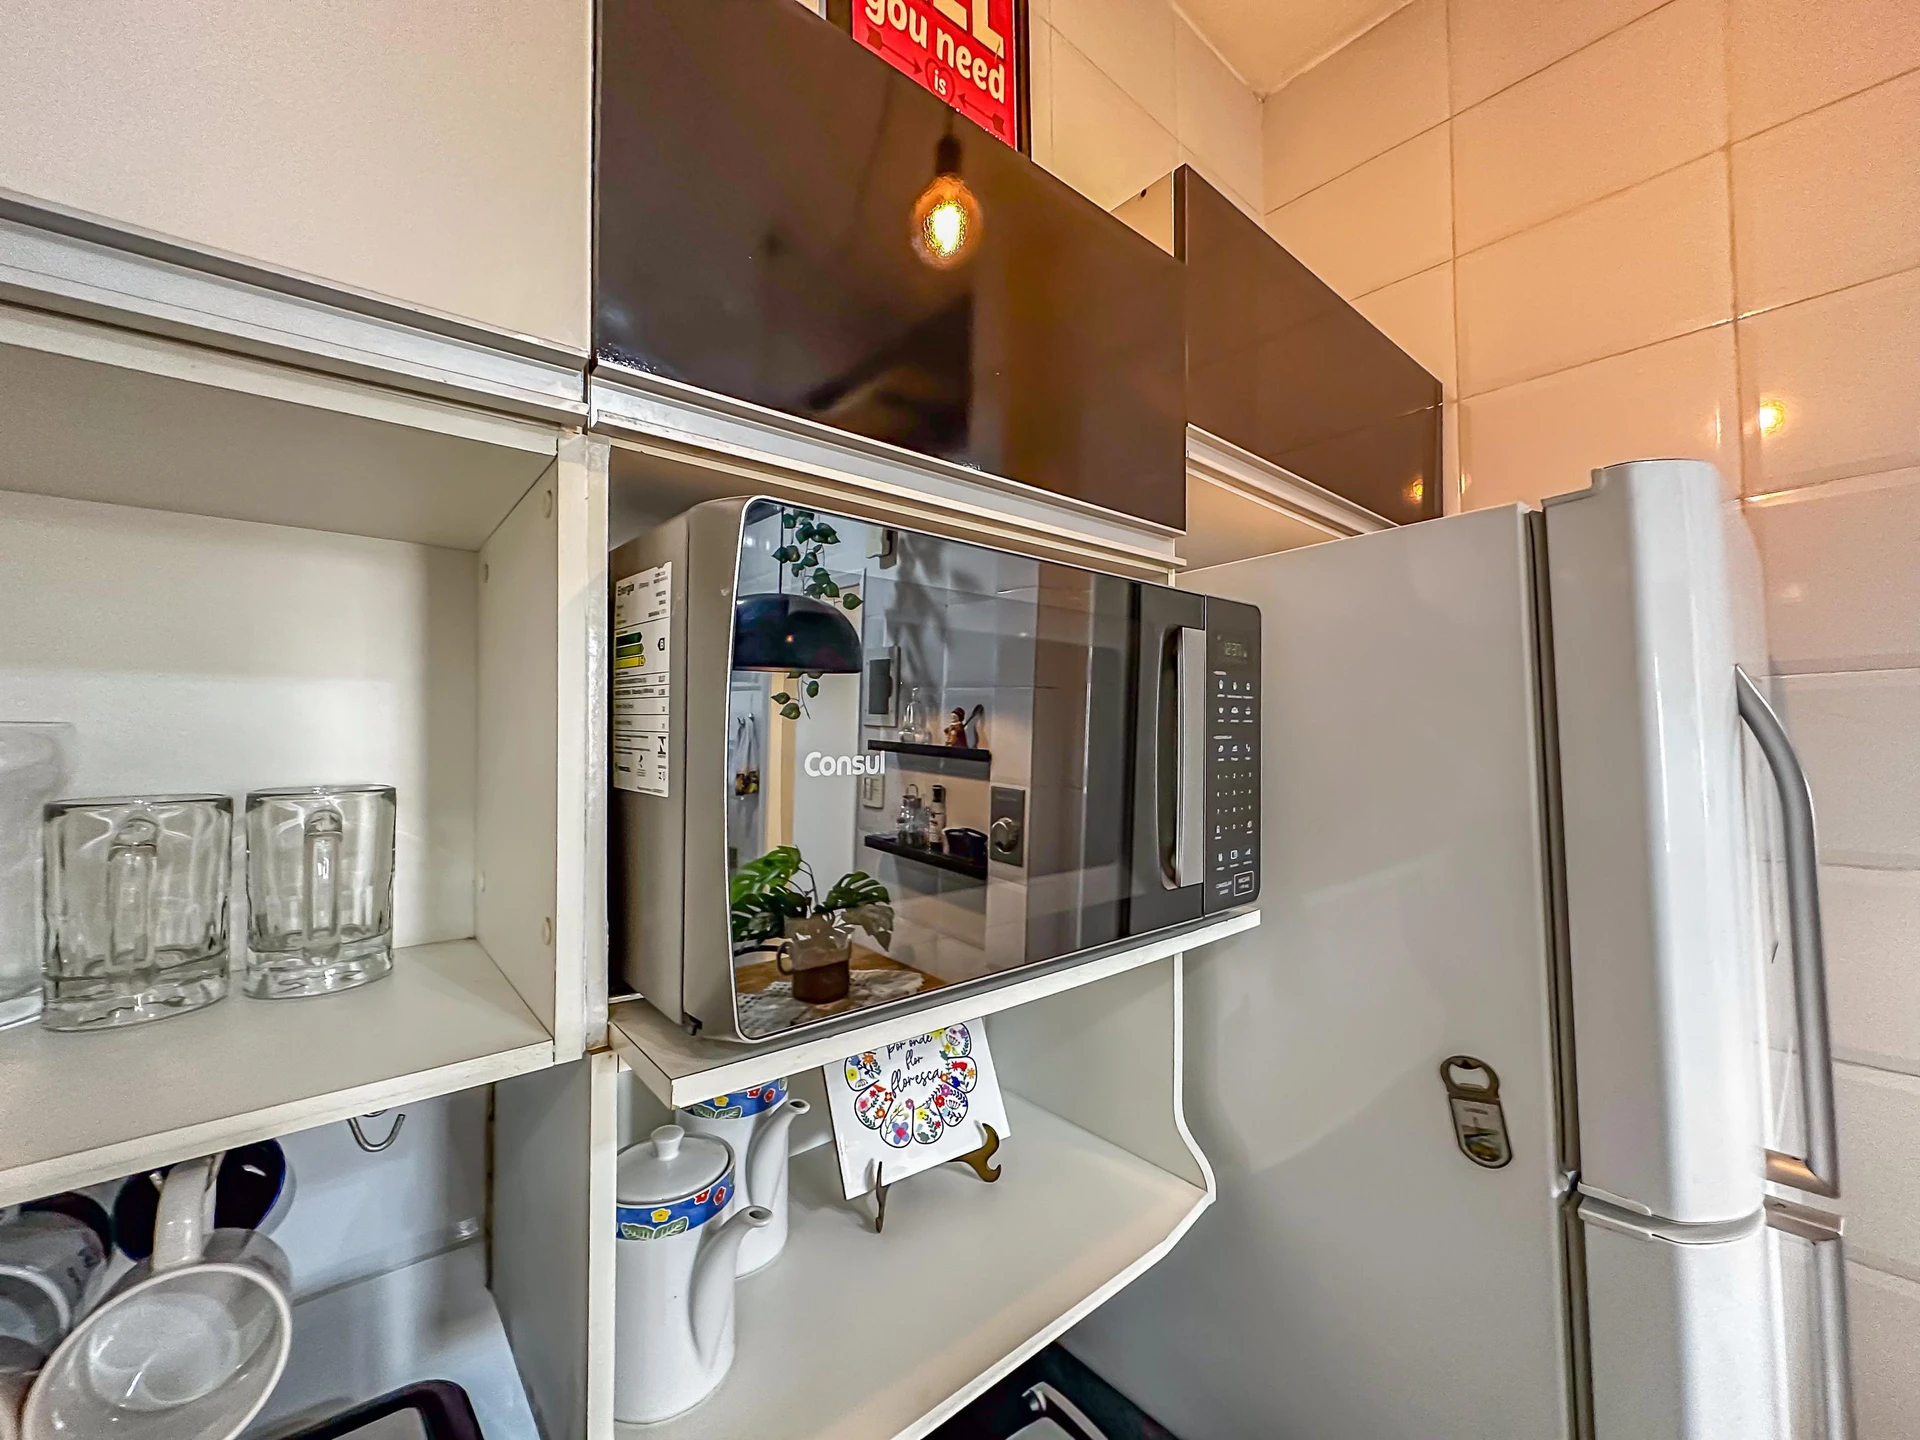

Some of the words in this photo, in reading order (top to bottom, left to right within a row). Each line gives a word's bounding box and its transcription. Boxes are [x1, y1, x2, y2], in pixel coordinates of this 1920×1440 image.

[865, 0, 928, 49] you
[936, 27, 1005, 104] need
[933, 69, 947, 96] is
[804, 750, 886, 777] Consul
